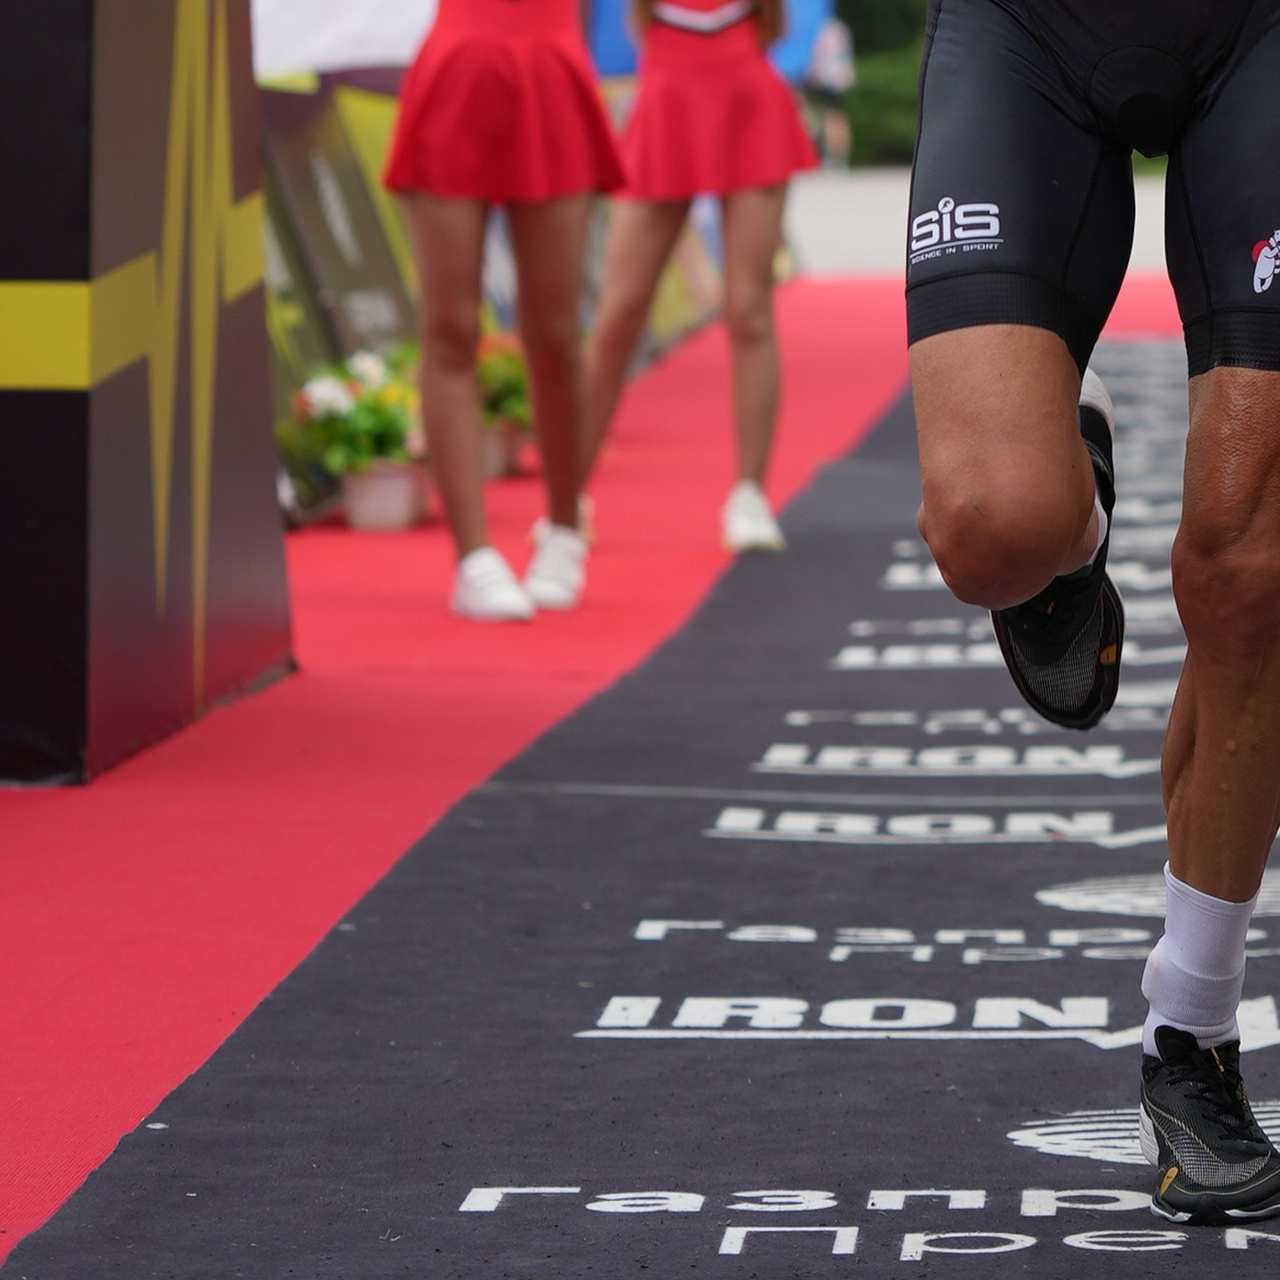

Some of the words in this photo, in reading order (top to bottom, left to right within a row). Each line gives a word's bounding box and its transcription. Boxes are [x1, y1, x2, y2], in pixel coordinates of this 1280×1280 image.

[946, 246, 957, 255] IN
[963, 242, 999, 252] SPORT
[715, 806, 1114, 835] IRON
[597, 996, 1109, 1028] IRON
